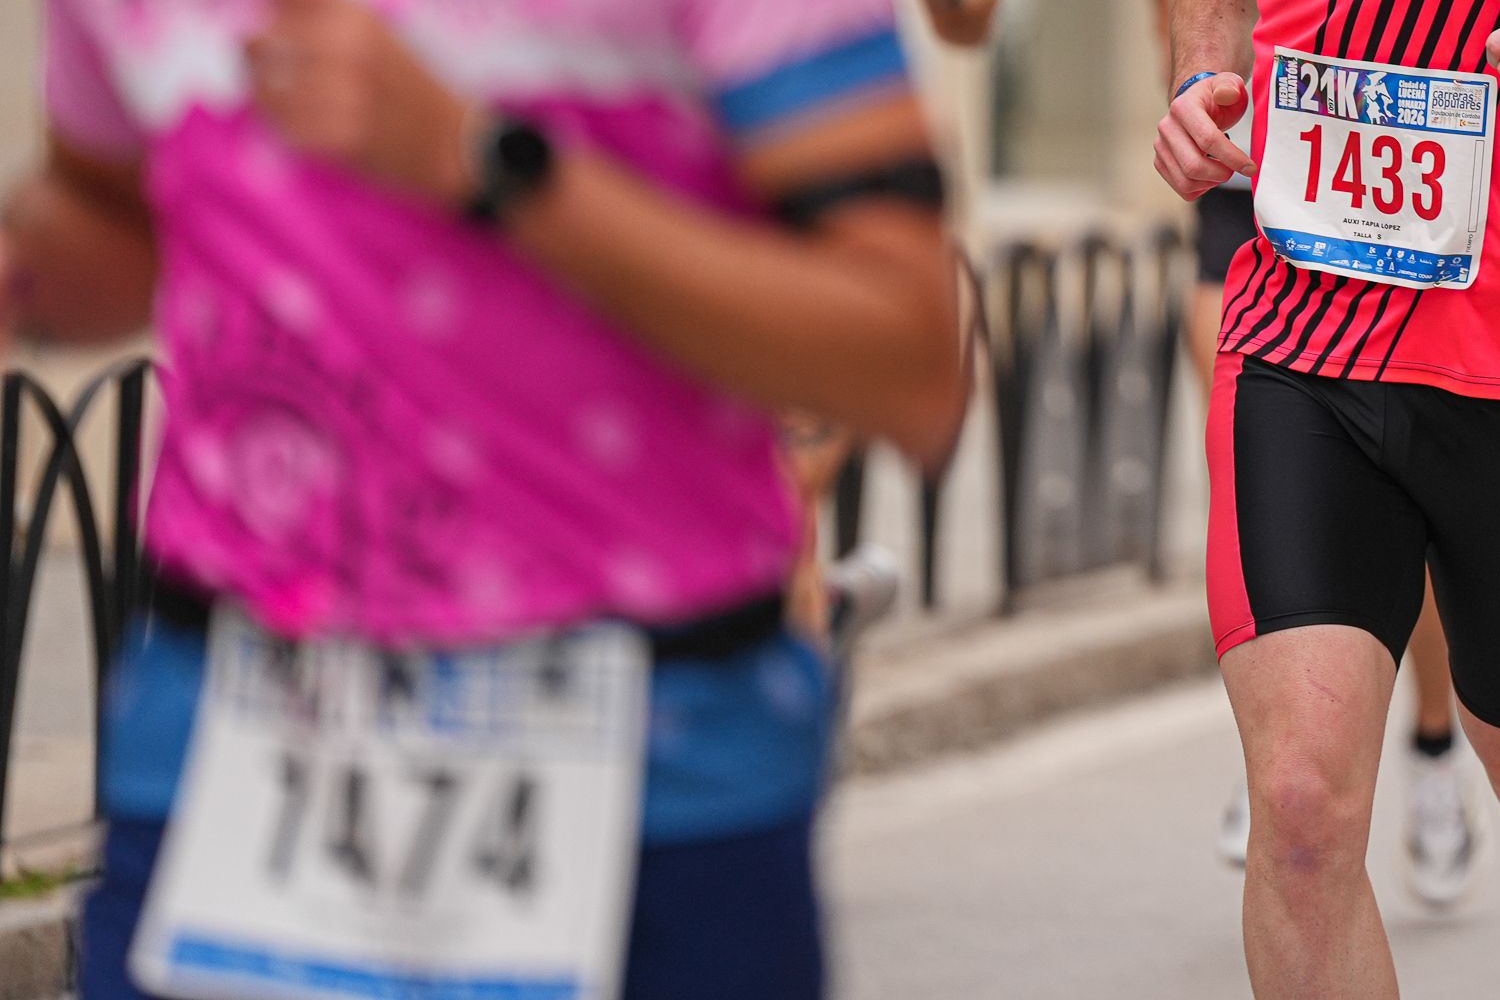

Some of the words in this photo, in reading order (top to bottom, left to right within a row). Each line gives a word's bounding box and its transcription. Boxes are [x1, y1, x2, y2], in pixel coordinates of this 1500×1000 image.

[1300, 62, 1359, 119] 21K
[1398, 79, 1419, 89] Ciudad
[1279, 76, 1288, 106] MEDIA
[1398, 87, 1426, 99] LUCENA
[1432, 90, 1474, 101] carreras
[1432, 97, 1481, 111] populares
[1397, 107, 1425, 125] 2026
[1431, 109, 1454, 117] Diputación
[1300, 124, 1446, 221] 1433
[1342, 217, 1360, 225] AUXI
[1361, 220, 1380, 228] TAPIA
[1353, 231, 1372, 239] TALLA
[265, 755, 538, 896] 1474
